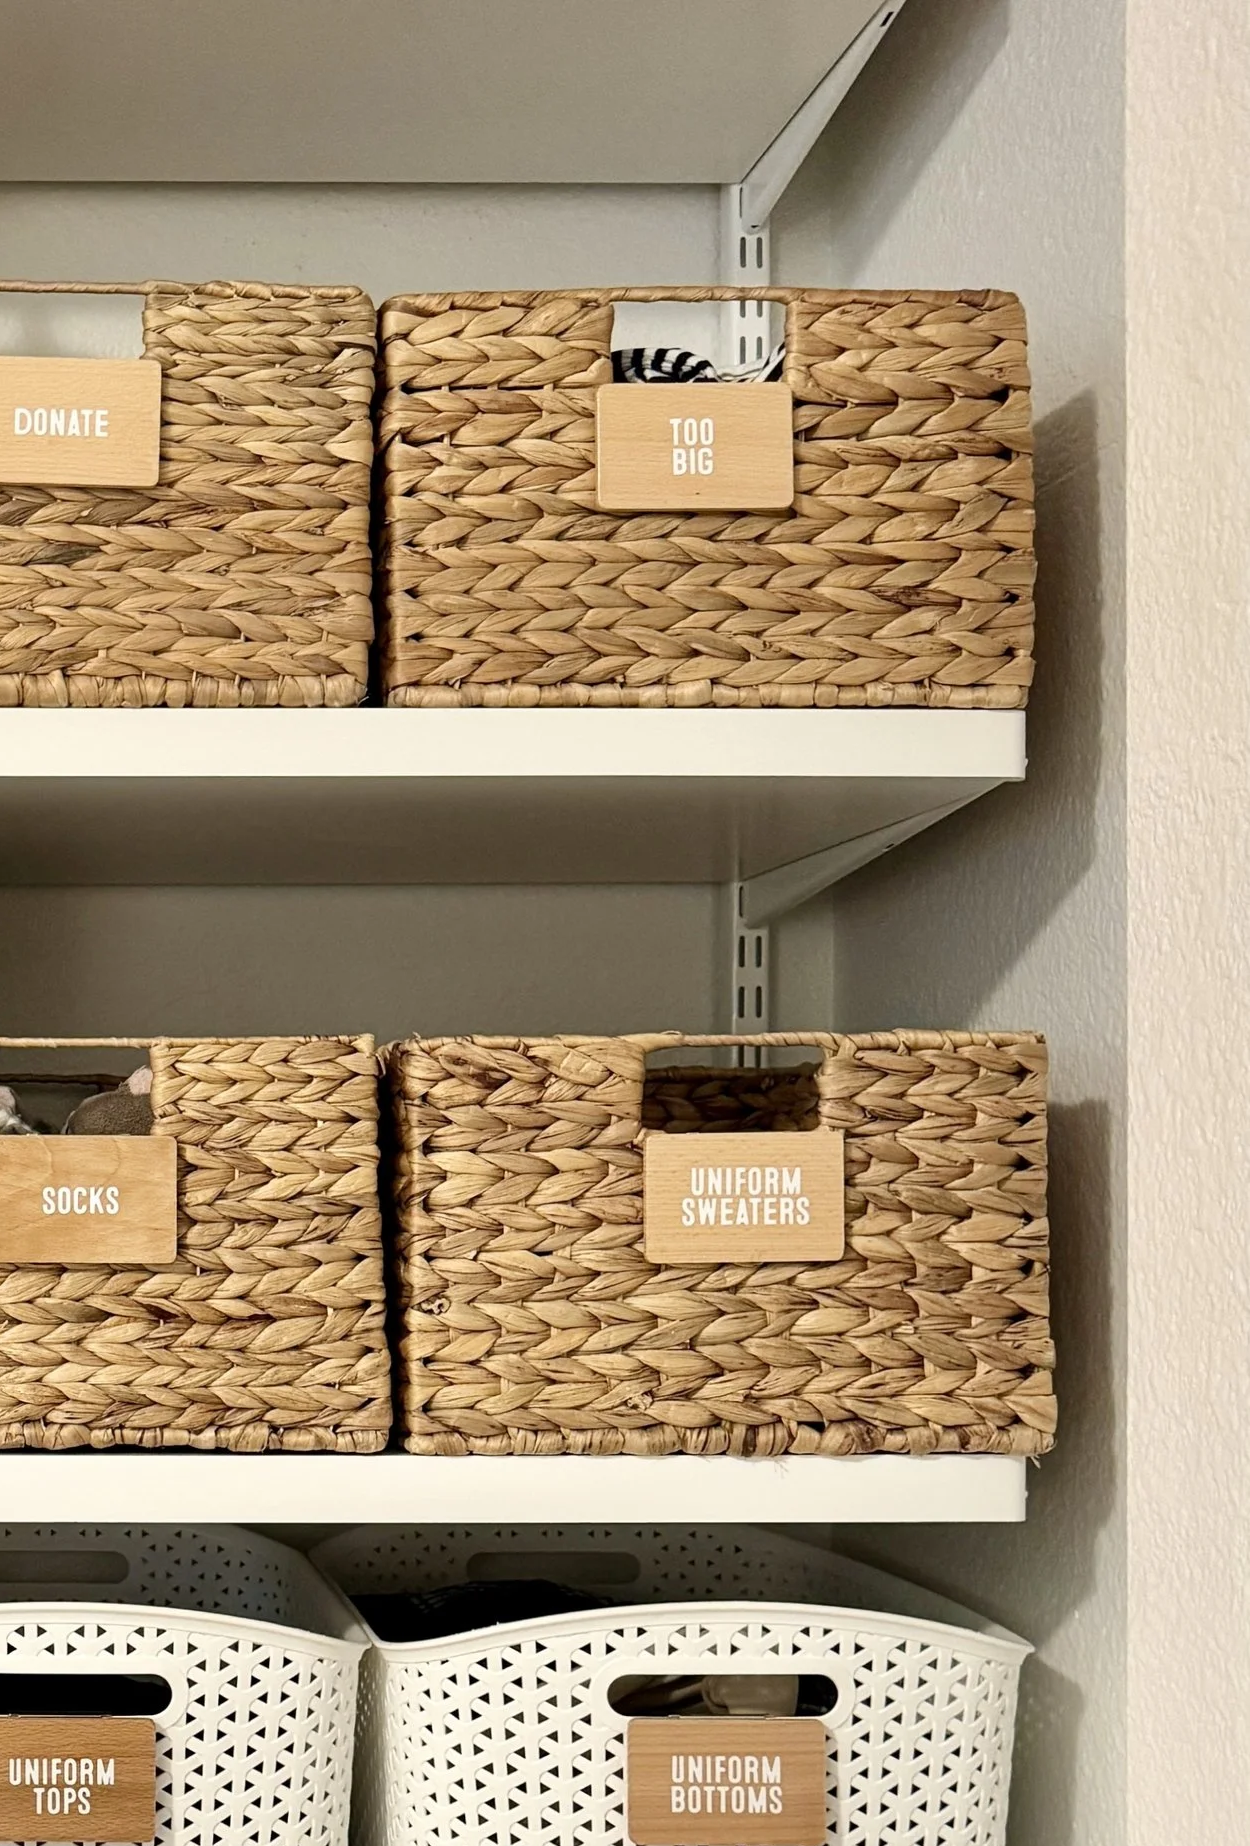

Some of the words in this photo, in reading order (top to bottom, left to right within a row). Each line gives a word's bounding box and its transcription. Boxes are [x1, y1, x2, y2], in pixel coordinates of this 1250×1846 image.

[14, 407, 108, 437] DONATE
[669, 417, 714, 446] TOO
[672, 447, 713, 476] BIG
[691, 1167, 801, 1196] UNIFORM
[42, 1186, 119, 1215] SOCKS
[682, 1196, 810, 1227] SWEATERS
[9, 1758, 115, 1786] UNIFORM
[671, 1755, 781, 1784] UNIFORM
[33, 1787, 91, 1815] TOPS
[671, 1785, 783, 1814] BOTTOMS
